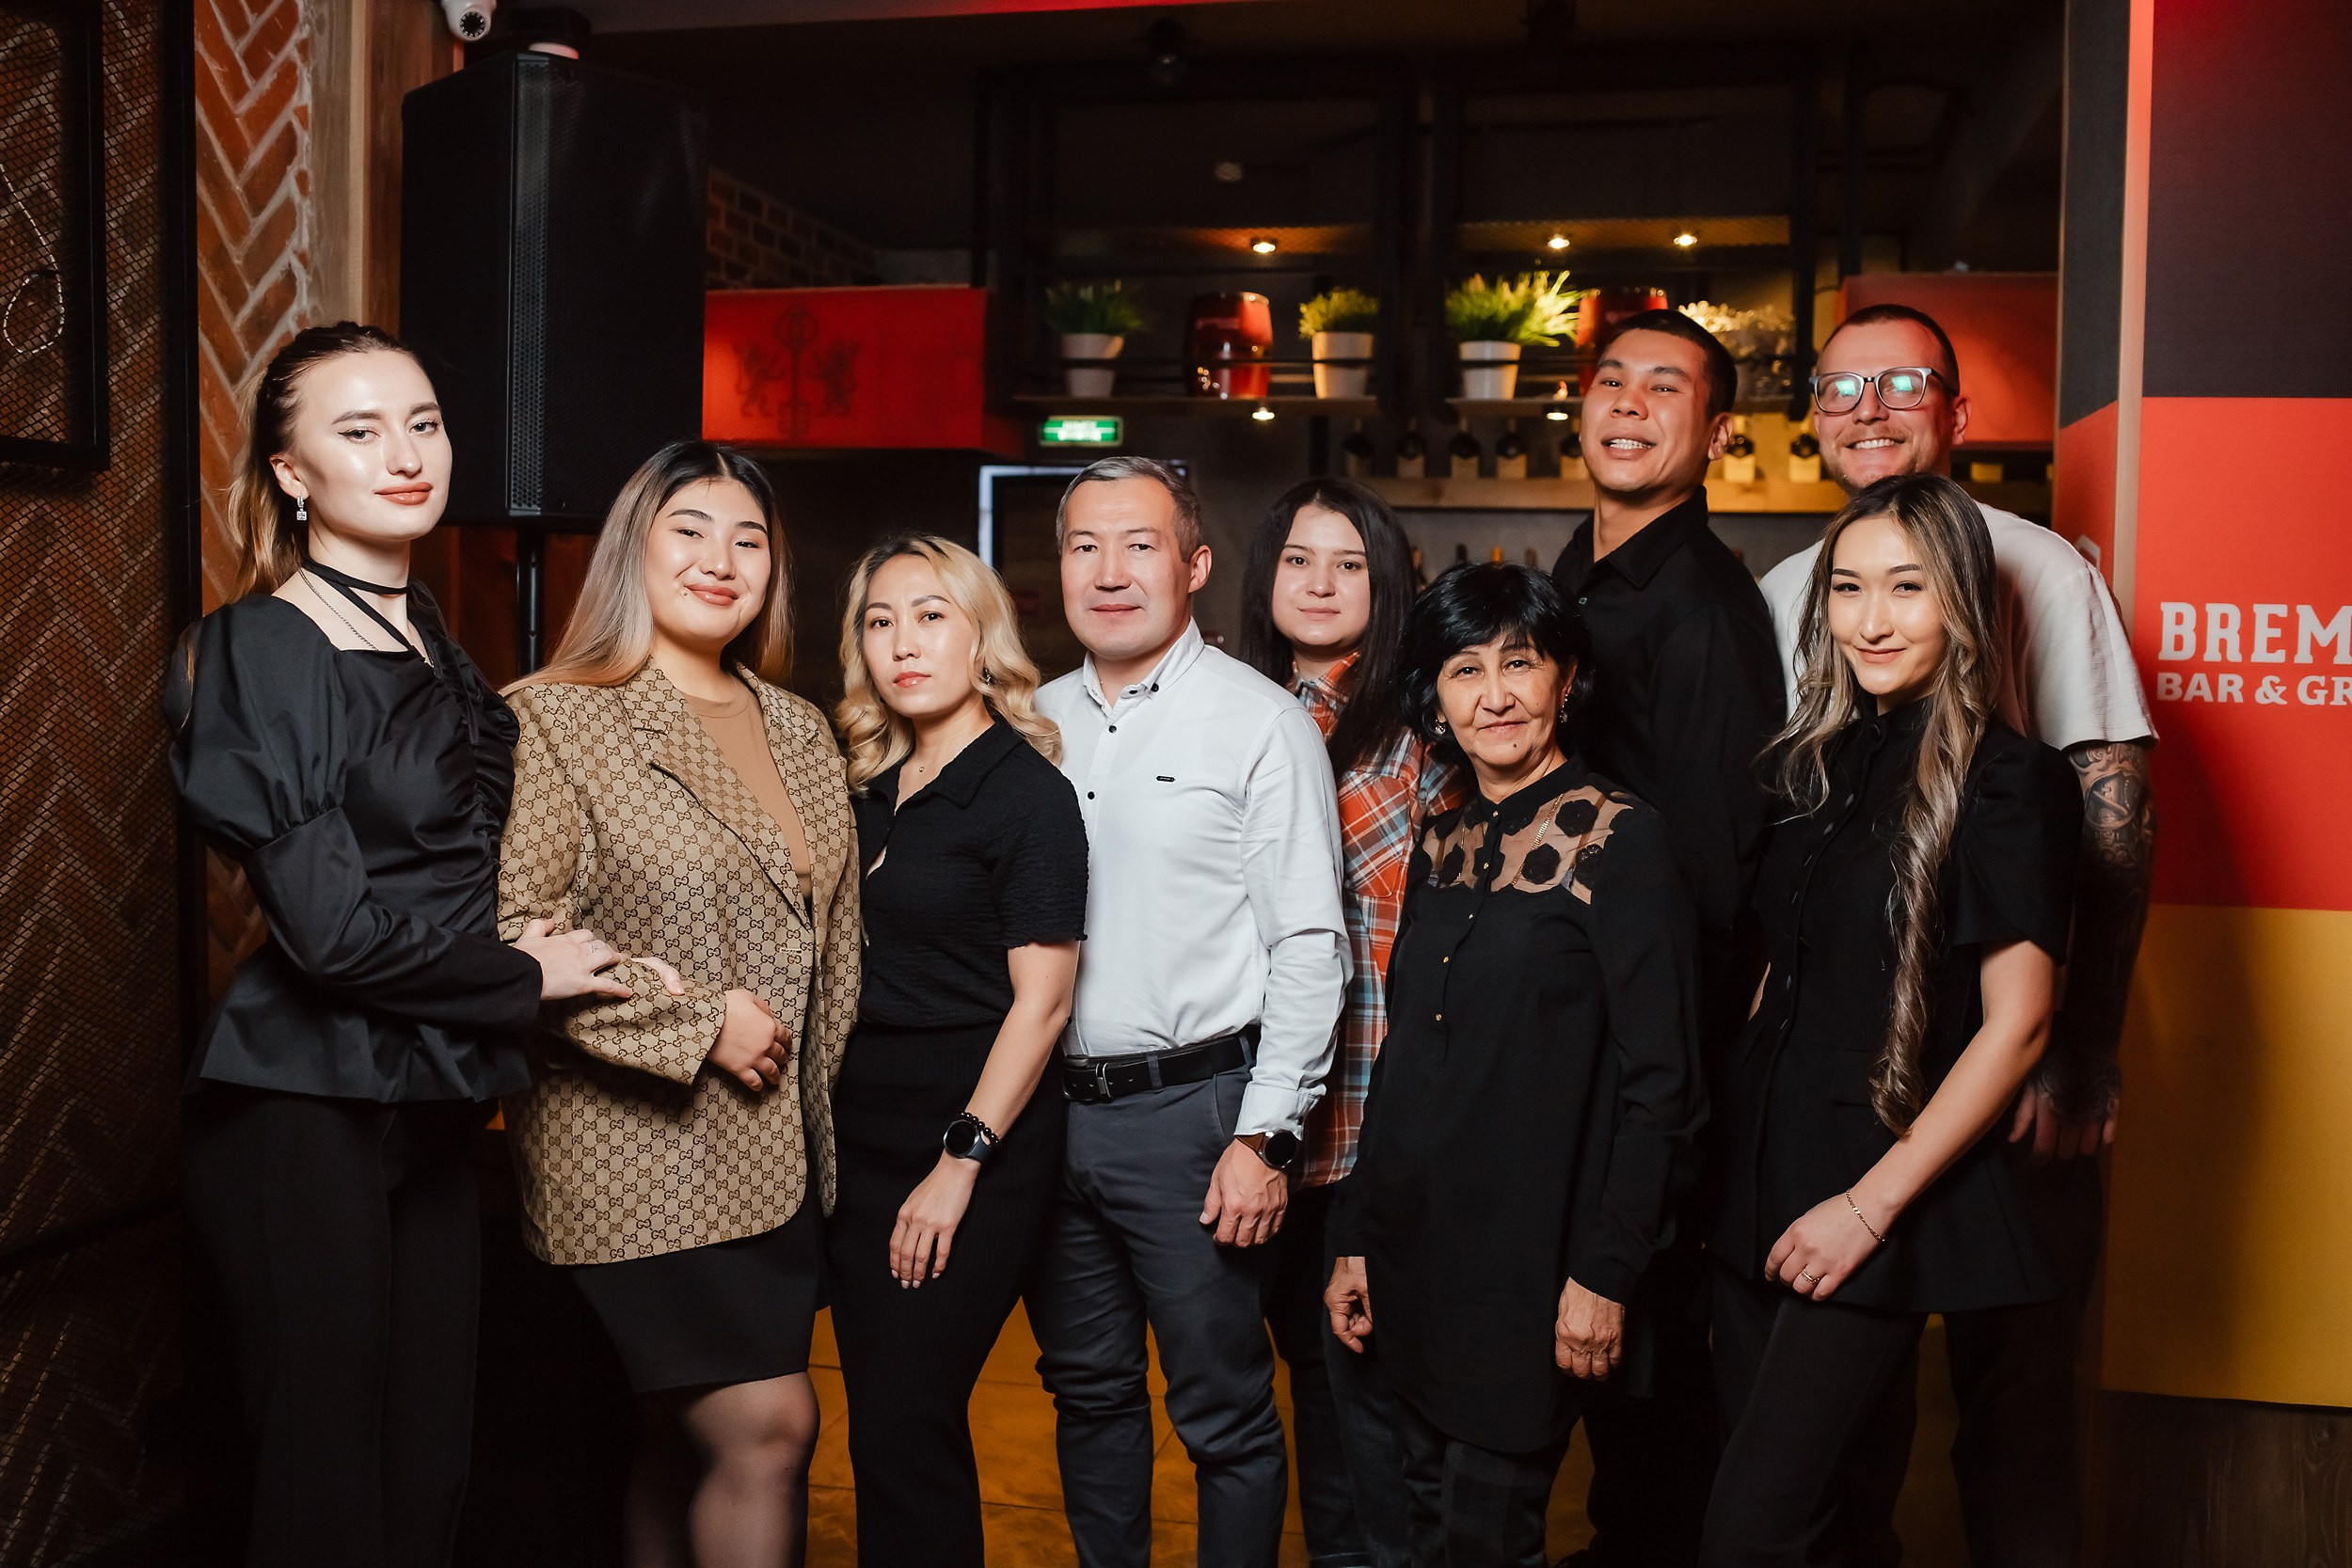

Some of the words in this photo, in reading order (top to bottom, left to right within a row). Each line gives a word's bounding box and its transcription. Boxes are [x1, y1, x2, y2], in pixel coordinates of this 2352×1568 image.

[2158, 602, 2352, 664] BREM
[2156, 673, 2244, 703] BAR
[2254, 675, 2287, 705] &
[2297, 675, 2352, 705] GR
